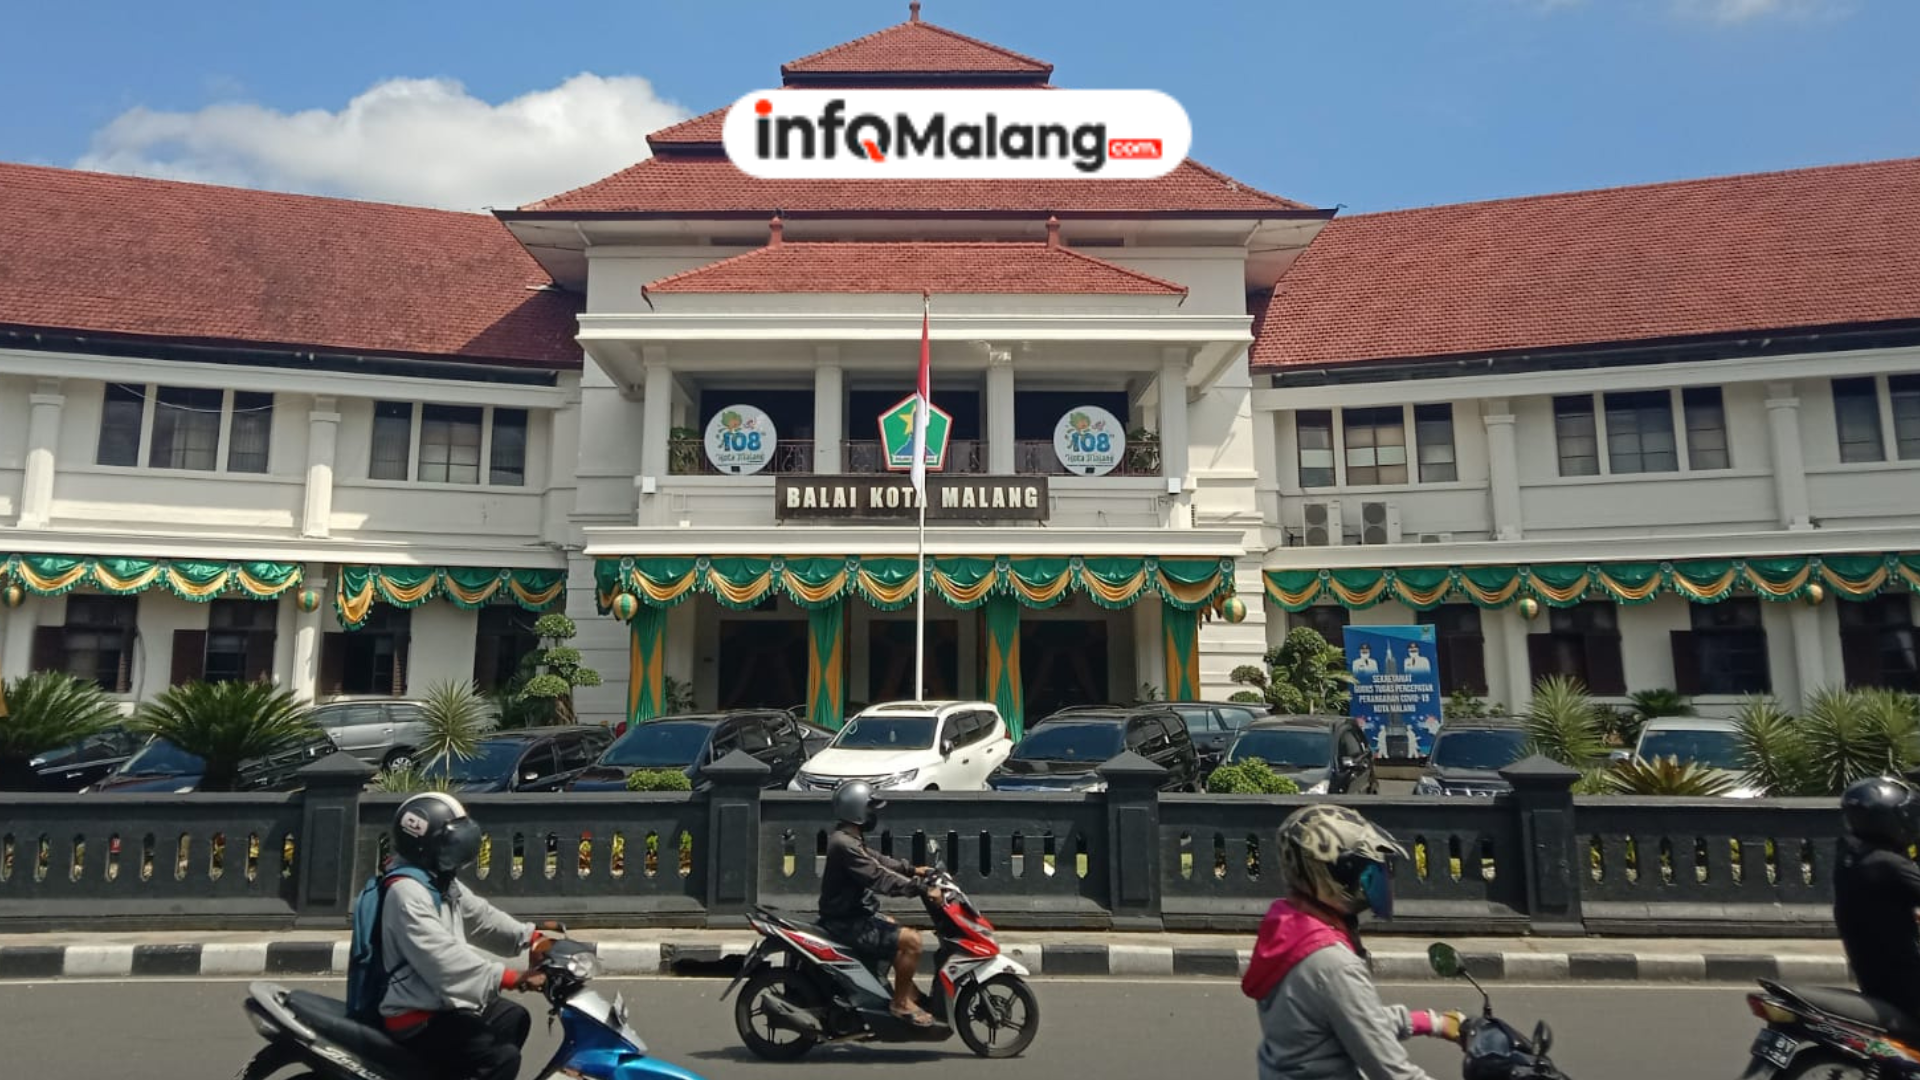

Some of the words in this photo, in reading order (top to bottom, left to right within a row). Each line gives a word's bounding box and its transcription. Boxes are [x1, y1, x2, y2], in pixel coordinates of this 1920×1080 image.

[723, 431, 762, 452] 108
[1071, 432, 1111, 453] 108
[786, 486, 857, 508] BALAI
[941, 486, 1039, 508] MALANG
